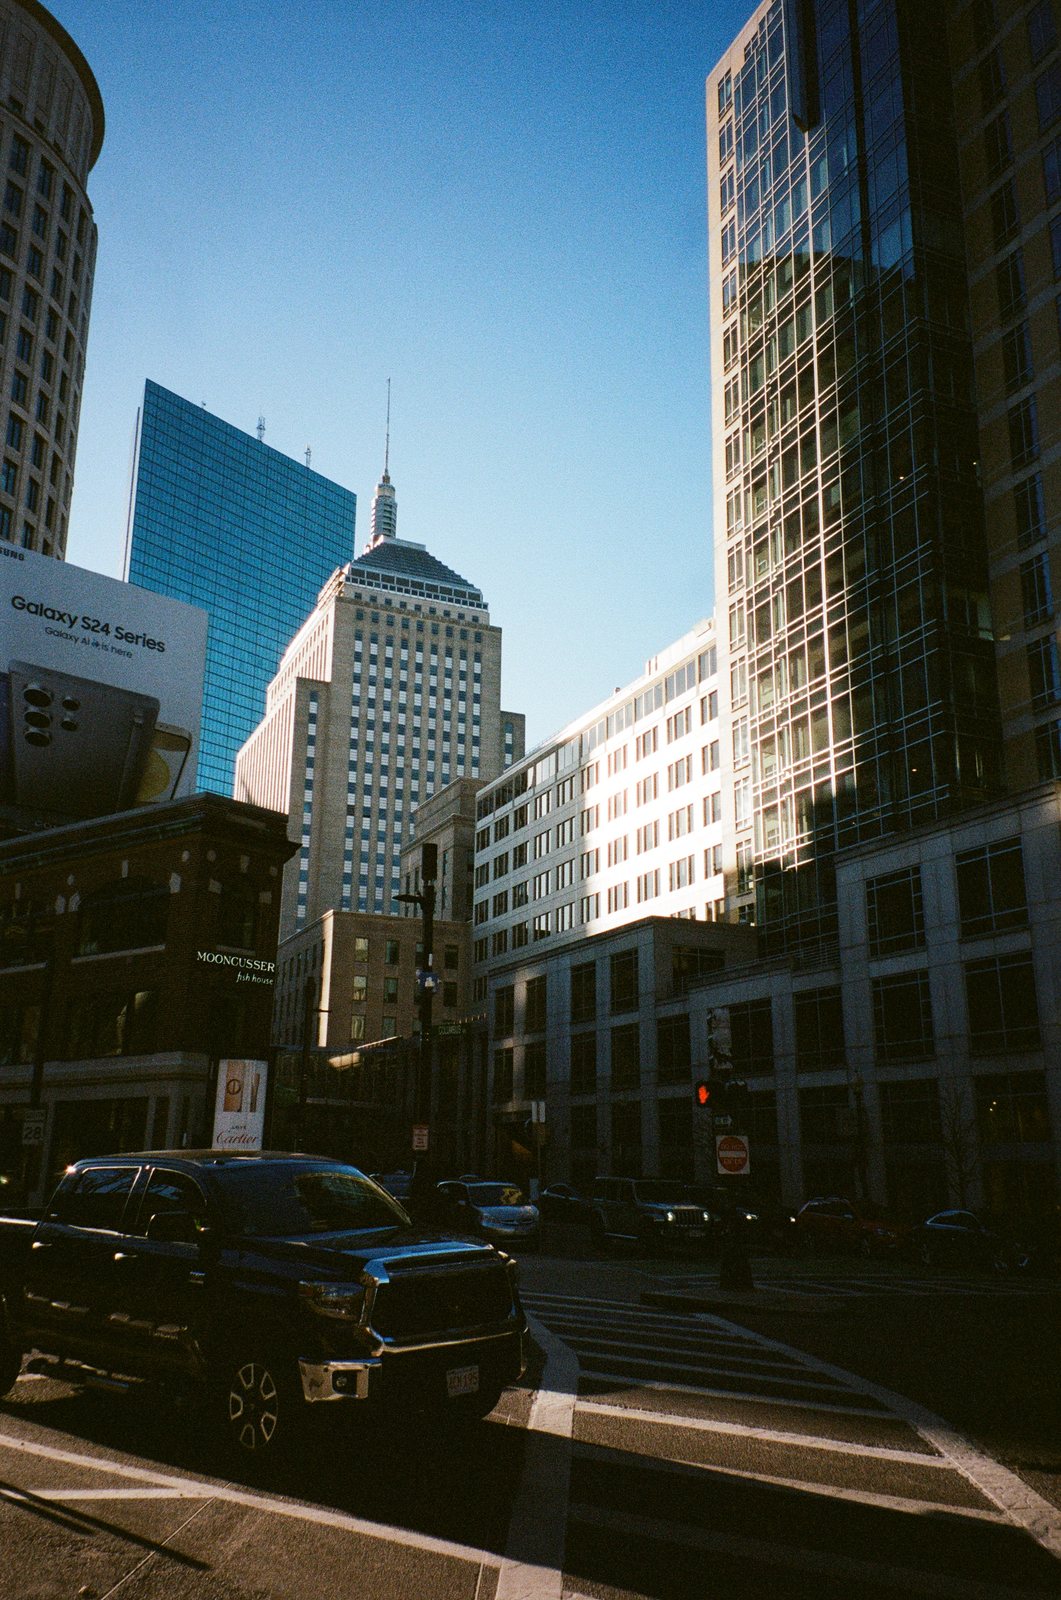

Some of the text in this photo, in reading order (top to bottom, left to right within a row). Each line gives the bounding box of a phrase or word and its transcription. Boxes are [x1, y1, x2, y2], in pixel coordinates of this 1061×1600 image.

[11, 595, 166, 653] Galaxy S24 Series
[45, 627, 79, 644] Galaxy
[111, 645, 133, 659] here
[196, 951, 275, 973] MOONCUSSER
[236, 971, 274, 986] fish house
[24, 1126, 42, 1140] 28
[216, 1130, 257, 1144] Cartier
